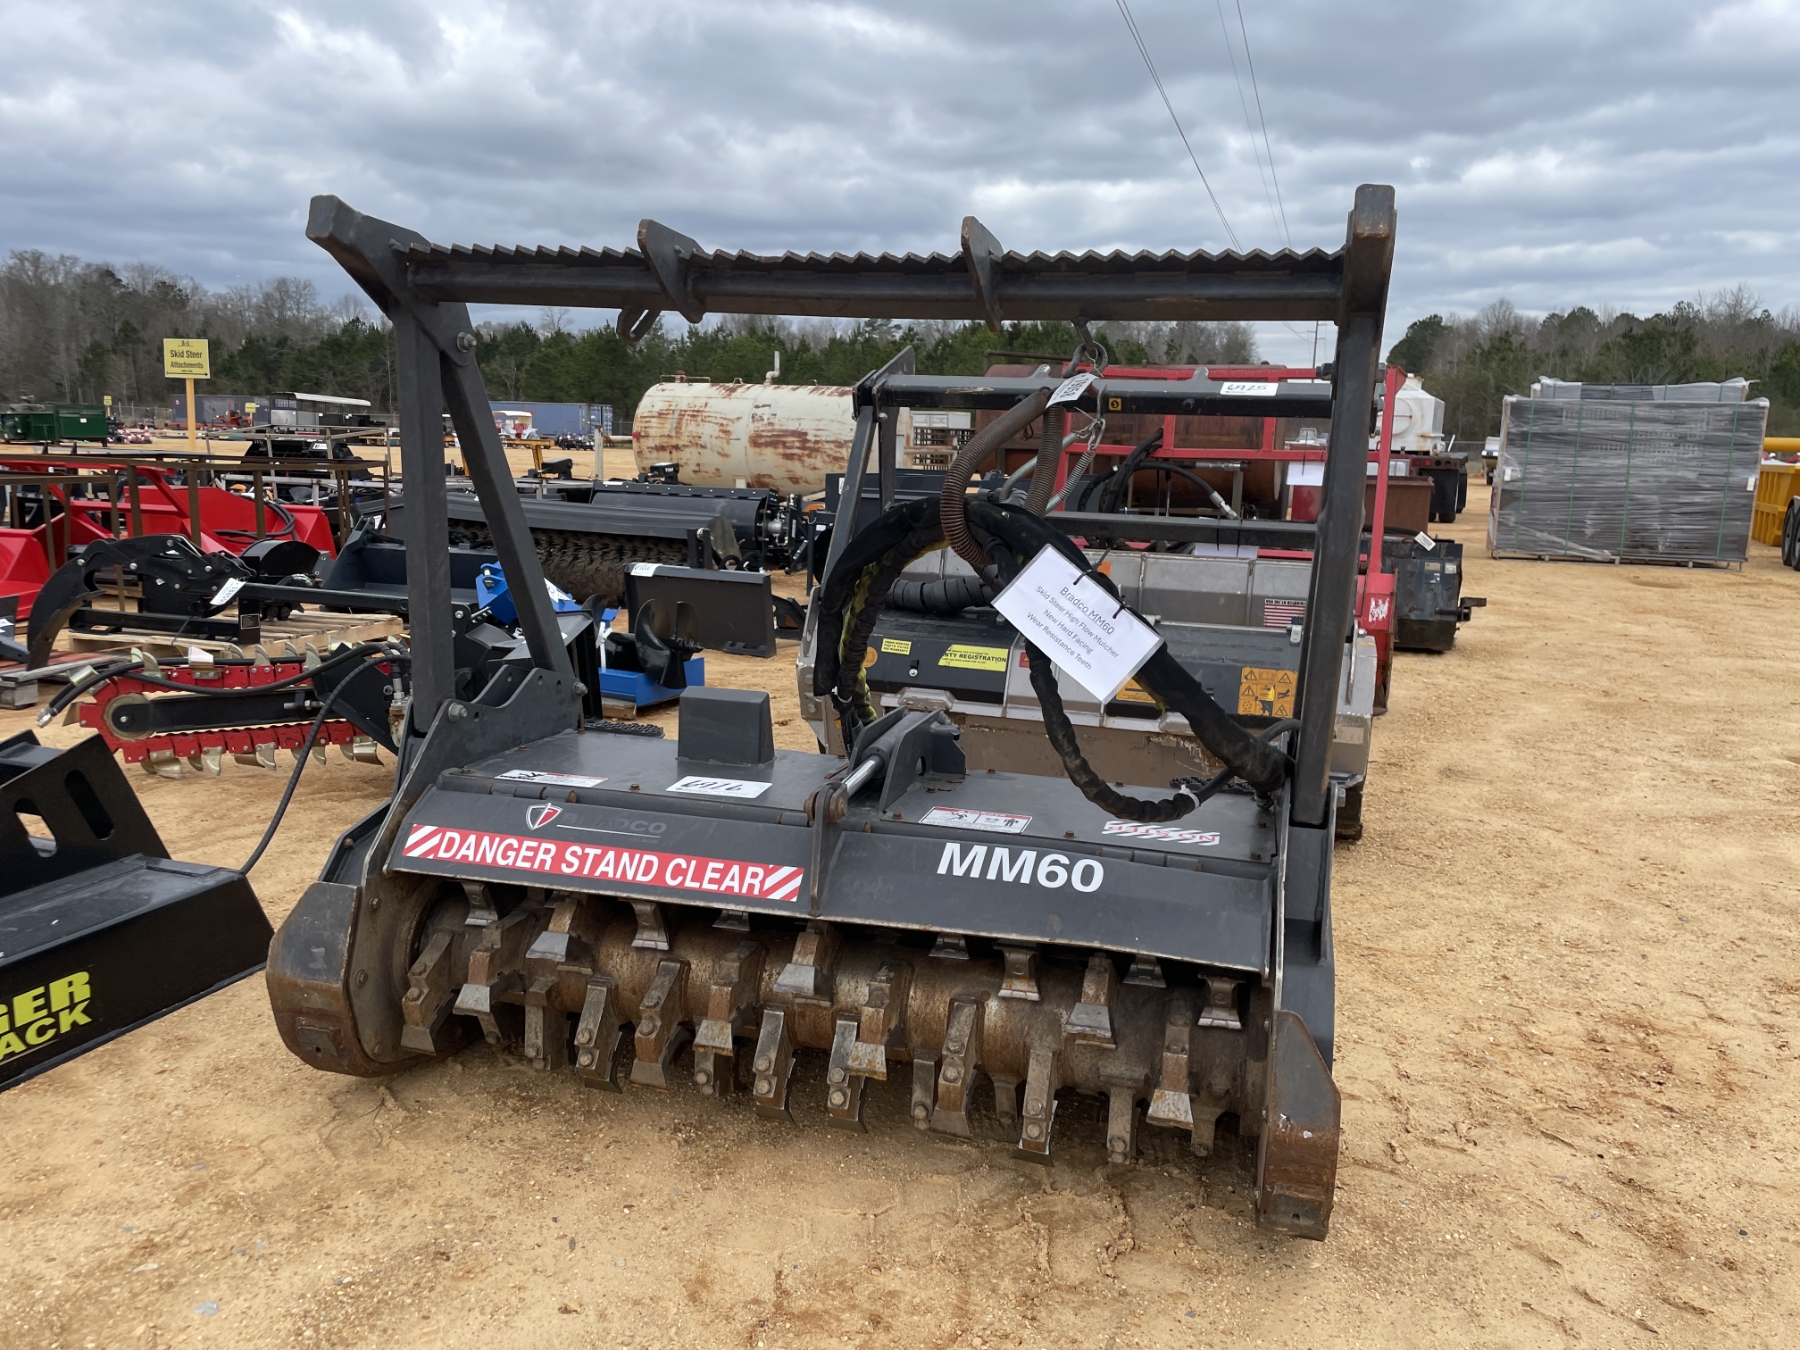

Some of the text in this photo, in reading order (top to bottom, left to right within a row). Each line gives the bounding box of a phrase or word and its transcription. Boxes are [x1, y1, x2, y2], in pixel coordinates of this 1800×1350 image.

[170, 349, 202, 358] Skid Steer
[170, 361, 204, 369] Attachments
[1036, 586, 1120, 658] Skid Steer High Flow Mulcher
[1043, 609, 1094, 655] New Hard Facing
[1060, 586, 1115, 635] Bradco MM60
[959, 653, 1007, 662] REGISTRATION
[1027, 612, 1092, 670] Wear Resistance Teeth
[437, 831, 766, 896] DANGER STAND CLEAR
[937, 842, 1105, 893] MM60
